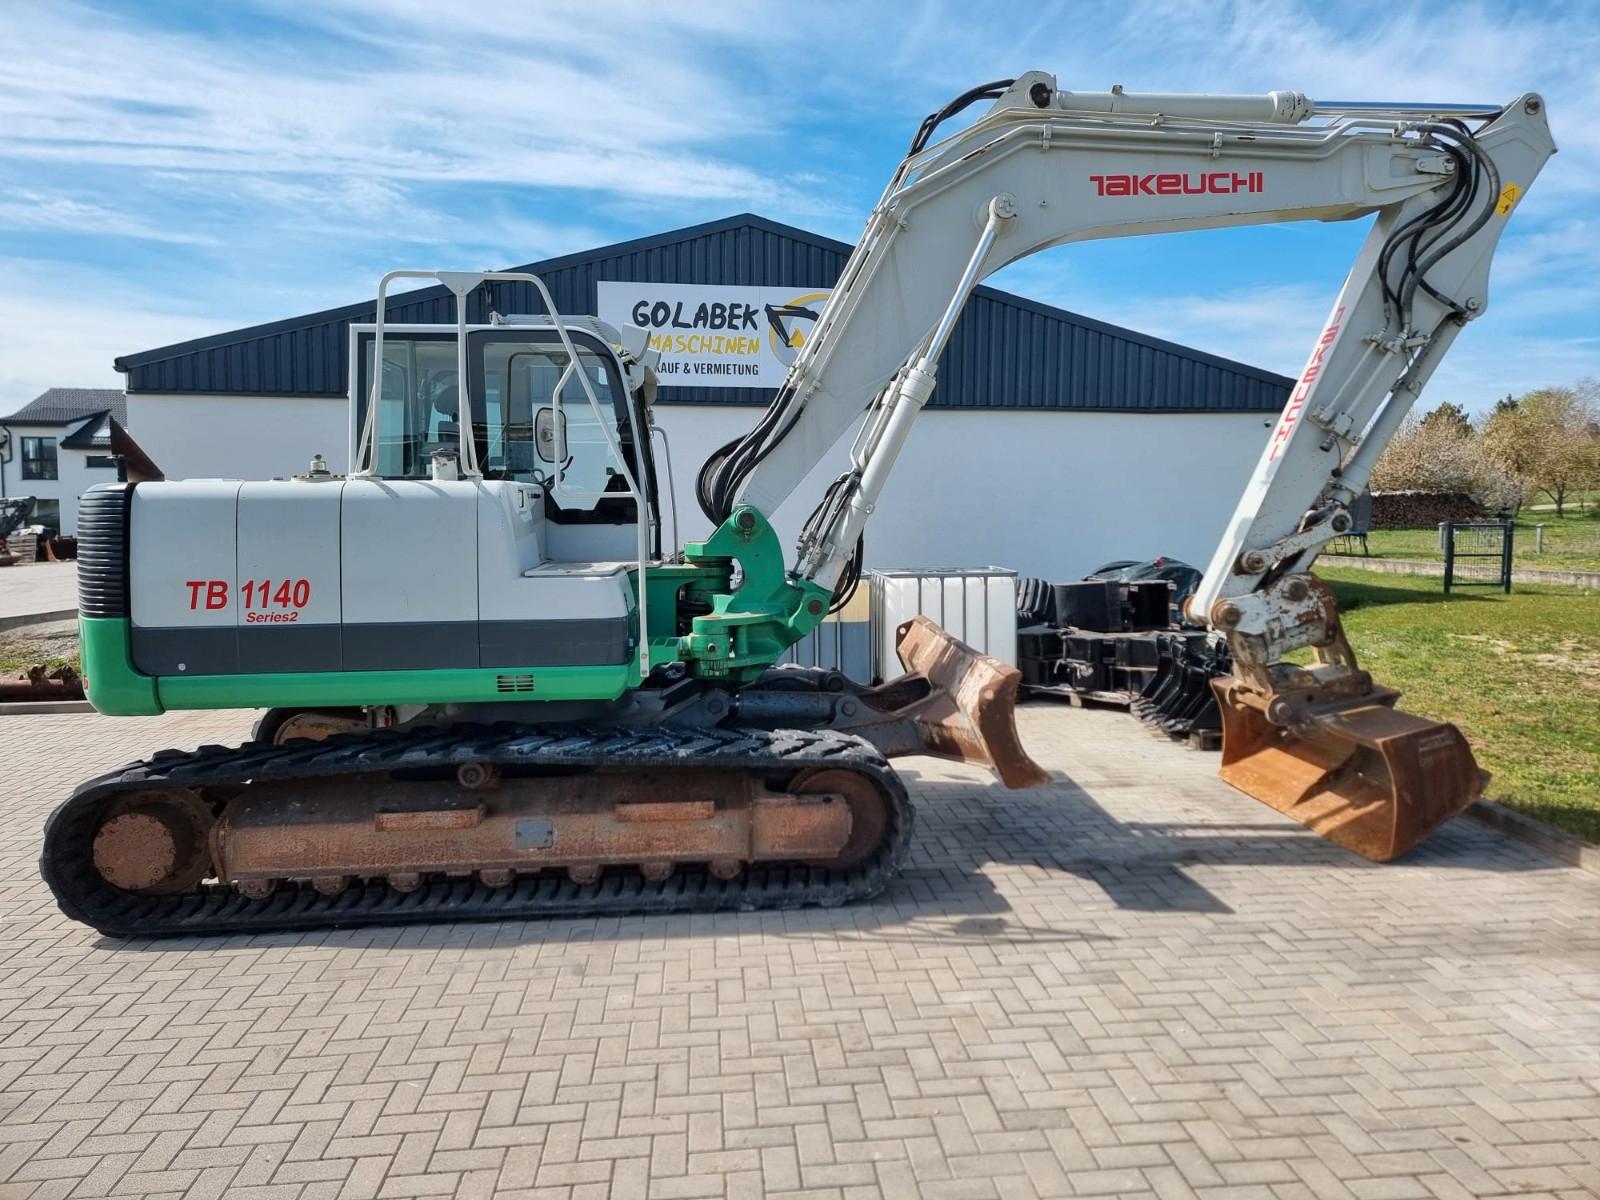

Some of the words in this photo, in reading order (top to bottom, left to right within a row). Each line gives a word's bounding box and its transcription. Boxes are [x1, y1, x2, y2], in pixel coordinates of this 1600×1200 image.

[632, 300, 760, 331] GOLABEK
[683, 362, 691, 375] &
[693, 362, 759, 376] VERMIETUNG
[186, 580, 229, 610] TB
[241, 579, 311, 609] 1140
[246, 611, 298, 623] Series2
